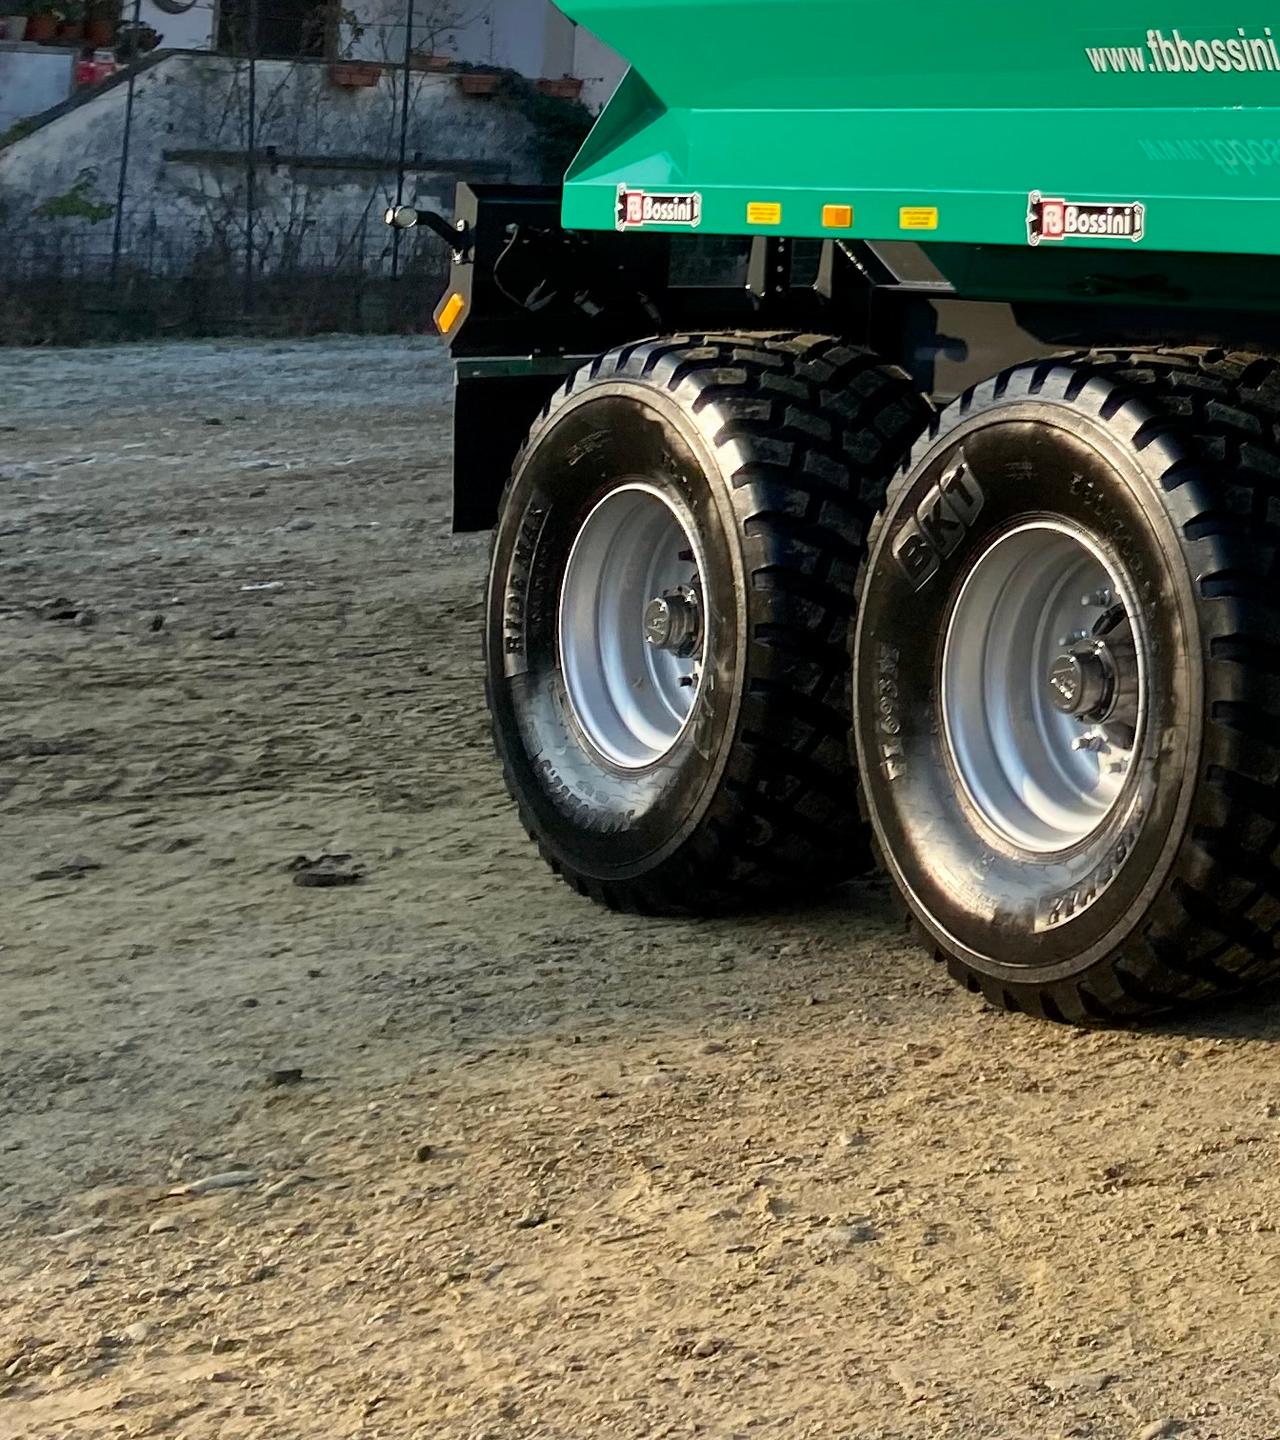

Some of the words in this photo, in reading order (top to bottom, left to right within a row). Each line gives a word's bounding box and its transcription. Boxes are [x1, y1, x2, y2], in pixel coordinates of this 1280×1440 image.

[643, 196, 691, 221] Bossini
[1065, 206, 1130, 234] Bossini
[896, 462, 977, 582] BKT
